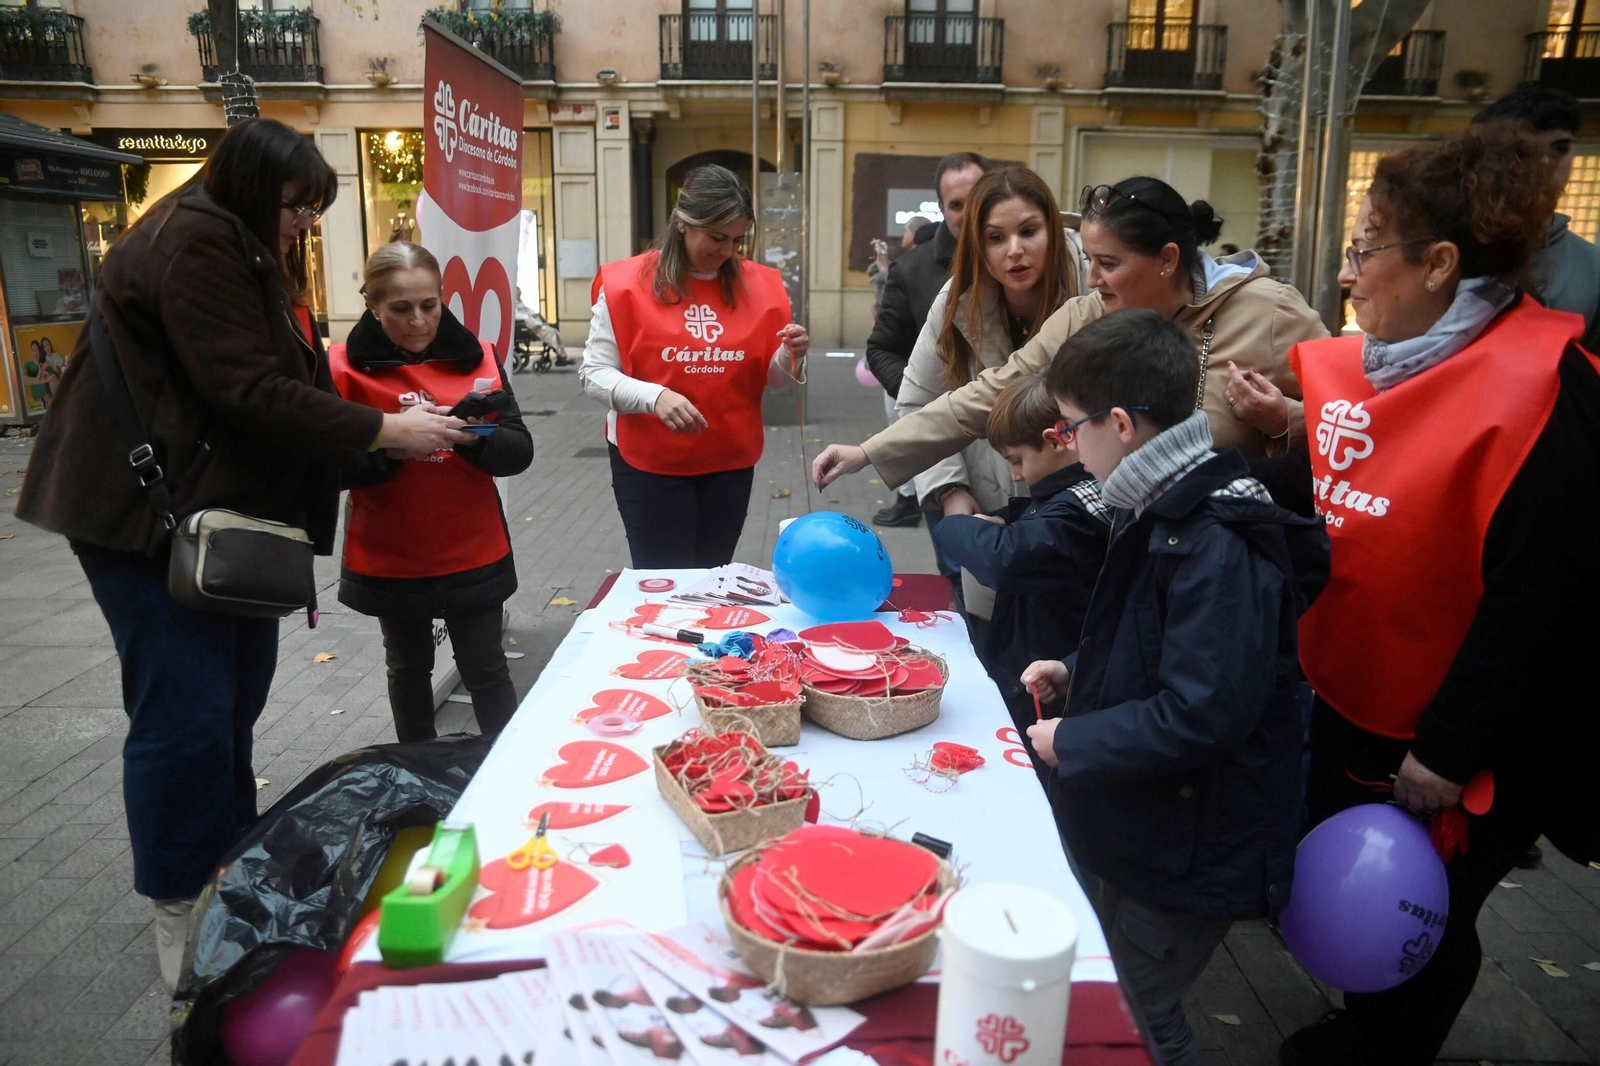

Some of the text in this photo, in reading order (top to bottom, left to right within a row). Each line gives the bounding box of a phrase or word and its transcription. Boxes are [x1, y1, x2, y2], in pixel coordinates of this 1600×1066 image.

[459, 98, 518, 152] Cáritas
[118, 133, 207, 153] renatta&go
[458, 135, 517, 169] Diocesana de Córdoba
[661, 346, 745, 363] Cáritas
[684, 365, 725, 374] Córdoba
[1312, 474, 1390, 517] ritas
[1398, 899, 1446, 929] ritas
